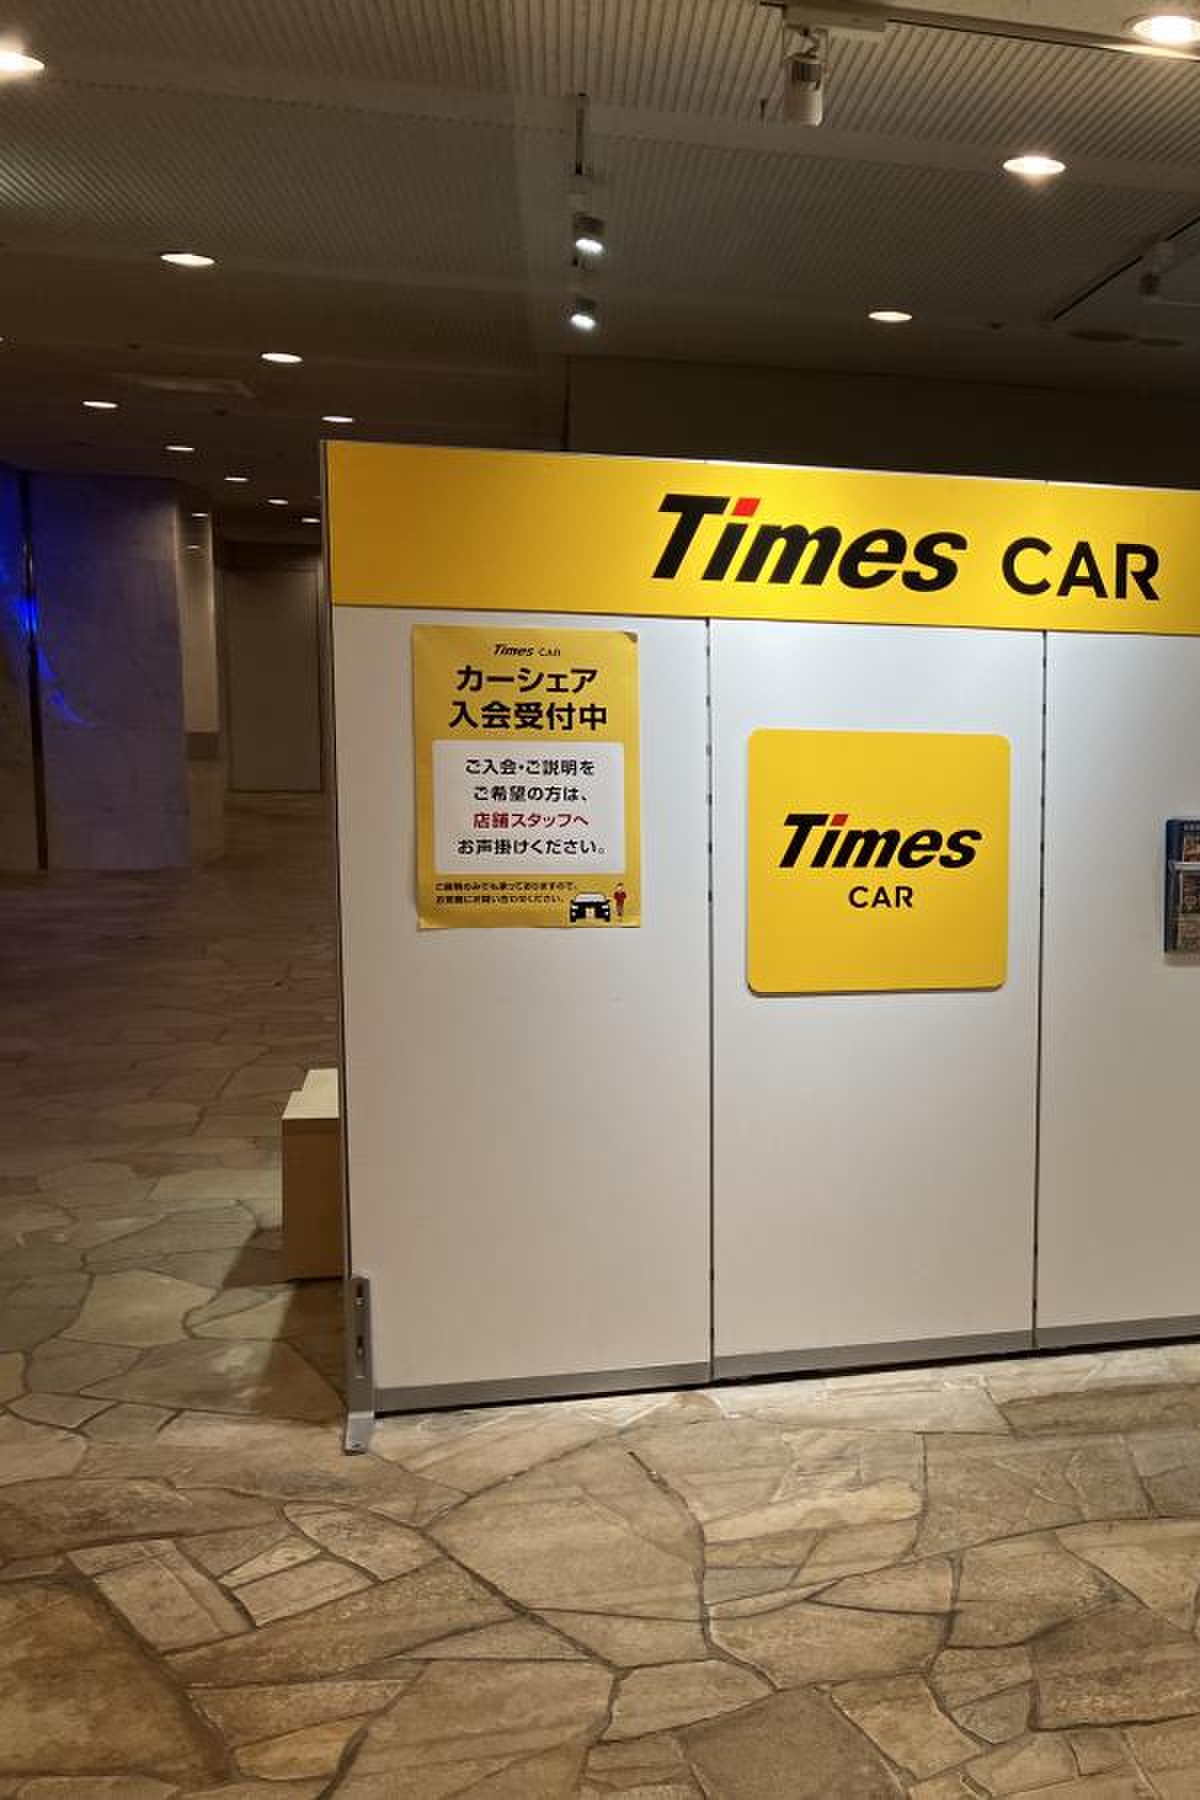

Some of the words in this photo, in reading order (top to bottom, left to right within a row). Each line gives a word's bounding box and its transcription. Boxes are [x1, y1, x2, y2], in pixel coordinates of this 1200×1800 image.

[652, 494, 968, 593] Times
[1001, 536, 1161, 601] CAR
[493, 643, 535, 657] Times
[456, 665, 598, 693] カーシェア
[449, 701, 607, 730] 入会受付中
[465, 758, 596, 776] ご入会・ご説明を
[473, 785, 588, 802] ご希望の方は、
[473, 812, 589, 829] 店舗スタッフへ
[457, 839, 607, 855] お声掛けください。
[779, 813, 983, 869] Times
[847, 885, 913, 908] CAR
